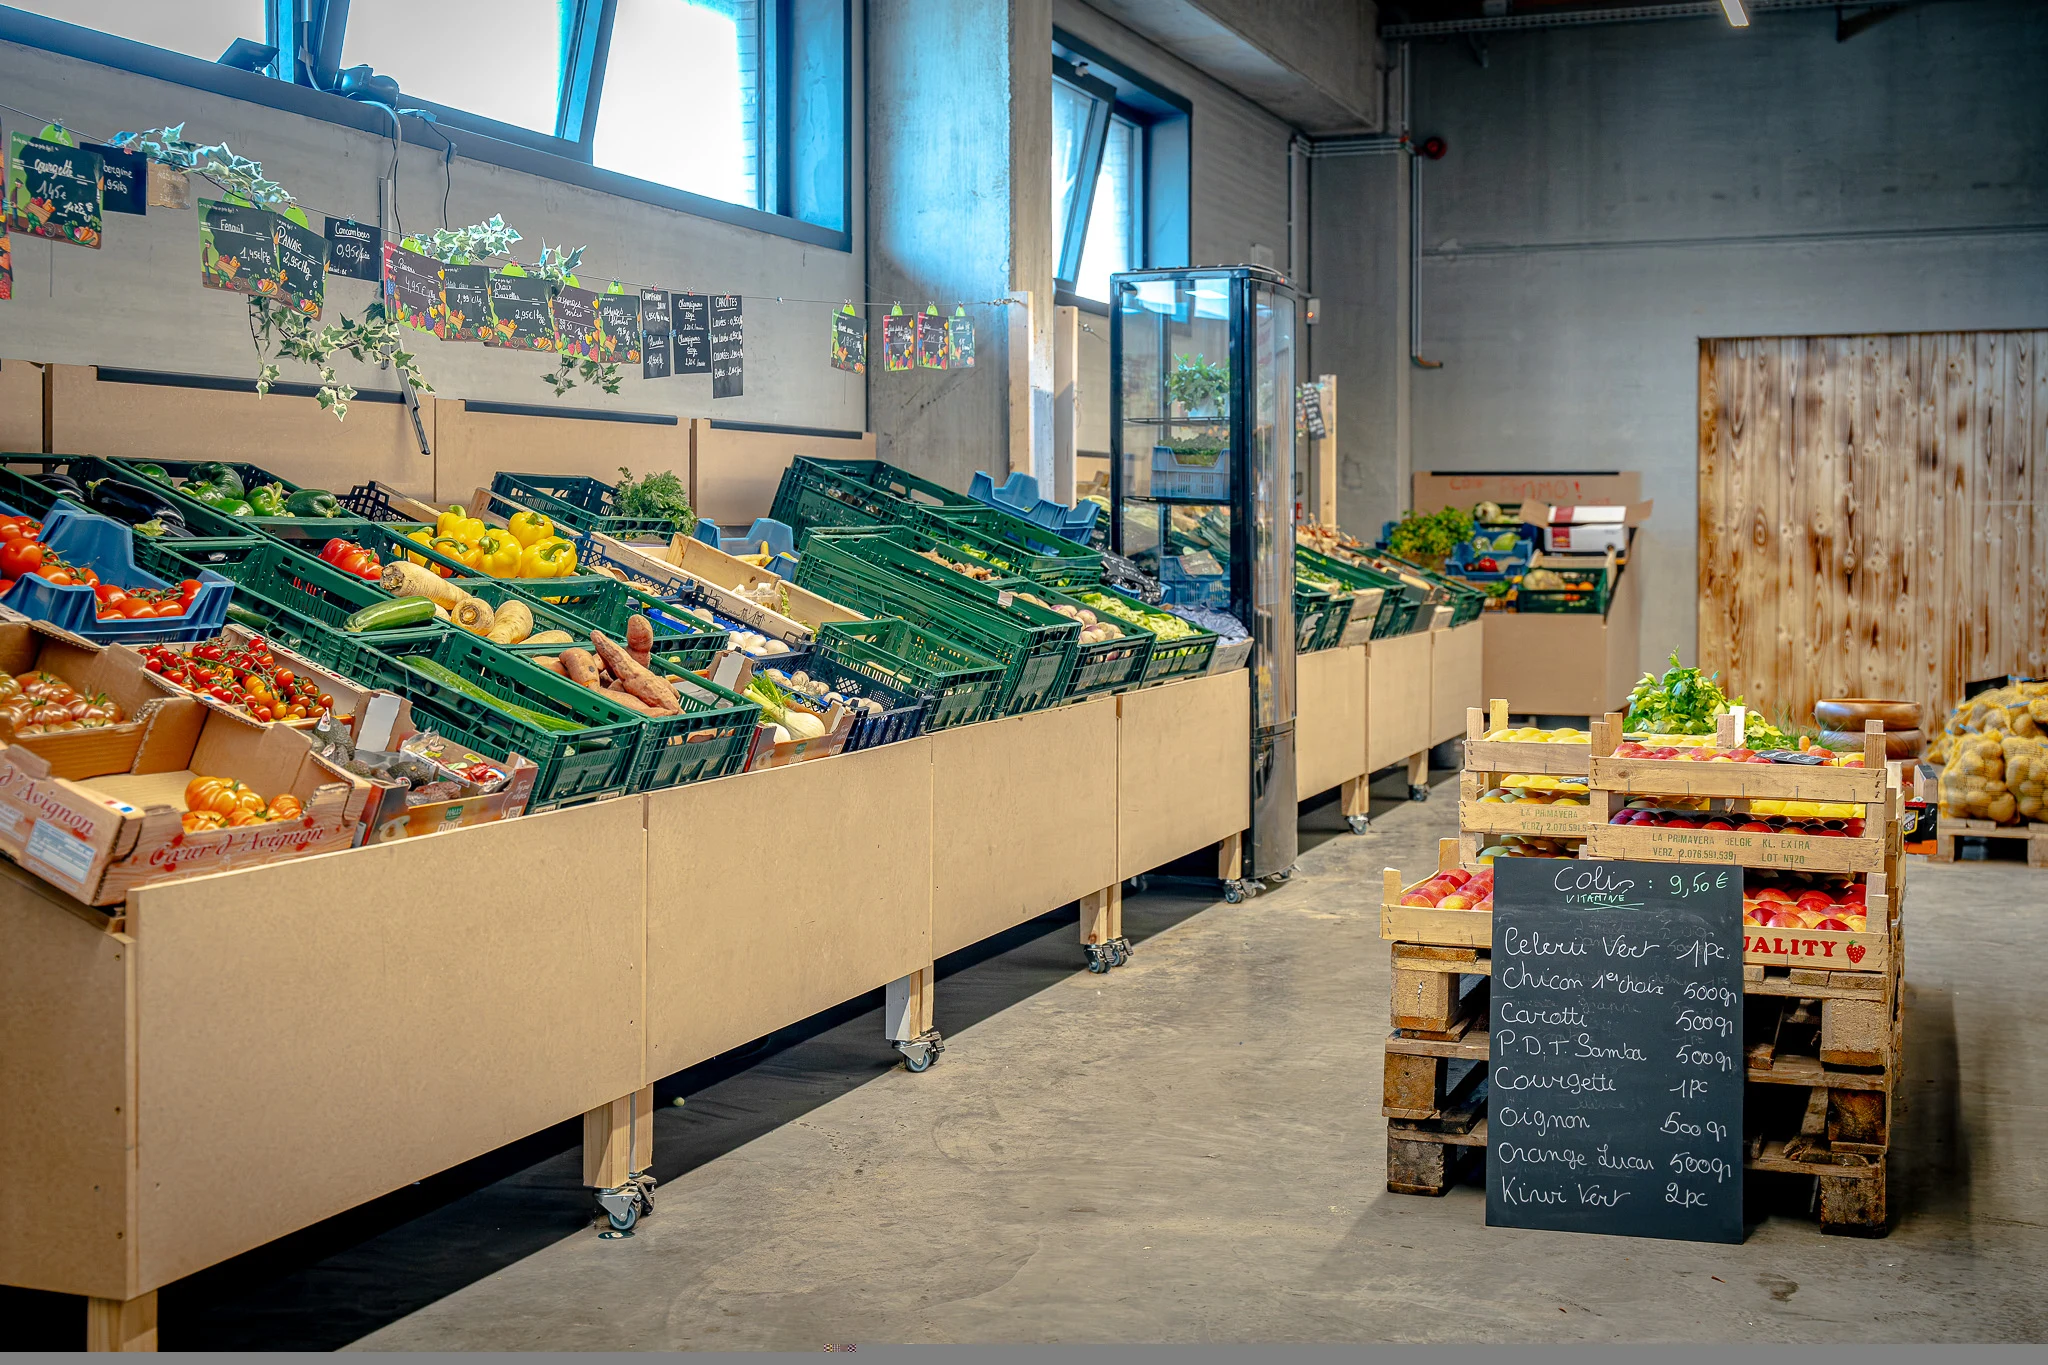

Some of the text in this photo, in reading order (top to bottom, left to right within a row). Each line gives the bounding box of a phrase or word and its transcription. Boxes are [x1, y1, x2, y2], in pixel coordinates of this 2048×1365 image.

[103, 160, 133, 178] bergine
[1652, 833, 1663, 842] LA
[1667, 833, 1715, 845] PRIMAVERA
[1780, 839, 1810, 850] EXTRA
[1653, 847, 1675, 857] VERZ.
[1761, 853, 1778, 863] LOT
[1554, 865, 1635, 893] Colis
[1602, 935, 1660, 958] Vert
[1618, 975, 1664, 995] choix
[1575, 1033, 1647, 1061] Samba
[1499, 1106, 1591, 1137] Oignon
[1498, 1142, 1587, 1170] Orange
[1578, 1183, 1631, 1207] Vert
